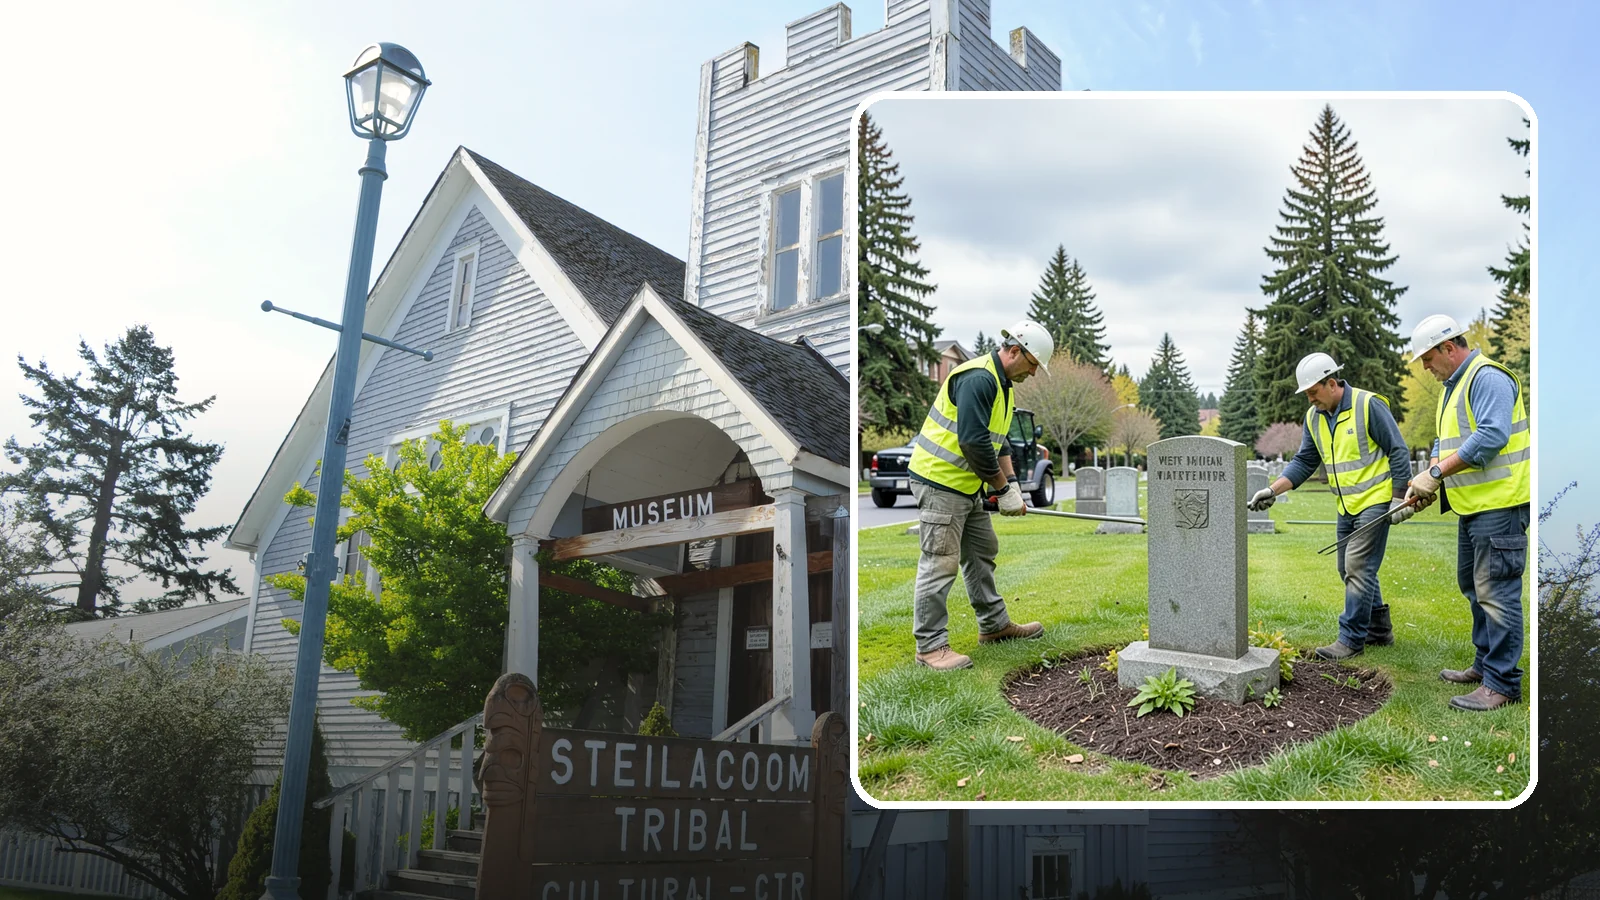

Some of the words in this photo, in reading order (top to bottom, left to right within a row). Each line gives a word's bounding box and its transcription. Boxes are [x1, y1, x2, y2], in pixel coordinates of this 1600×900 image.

[612, 491, 714, 531] MUSEUM
[550, 738, 810, 793] STEILACOOM
[614, 806, 758, 852] TRIBAL
